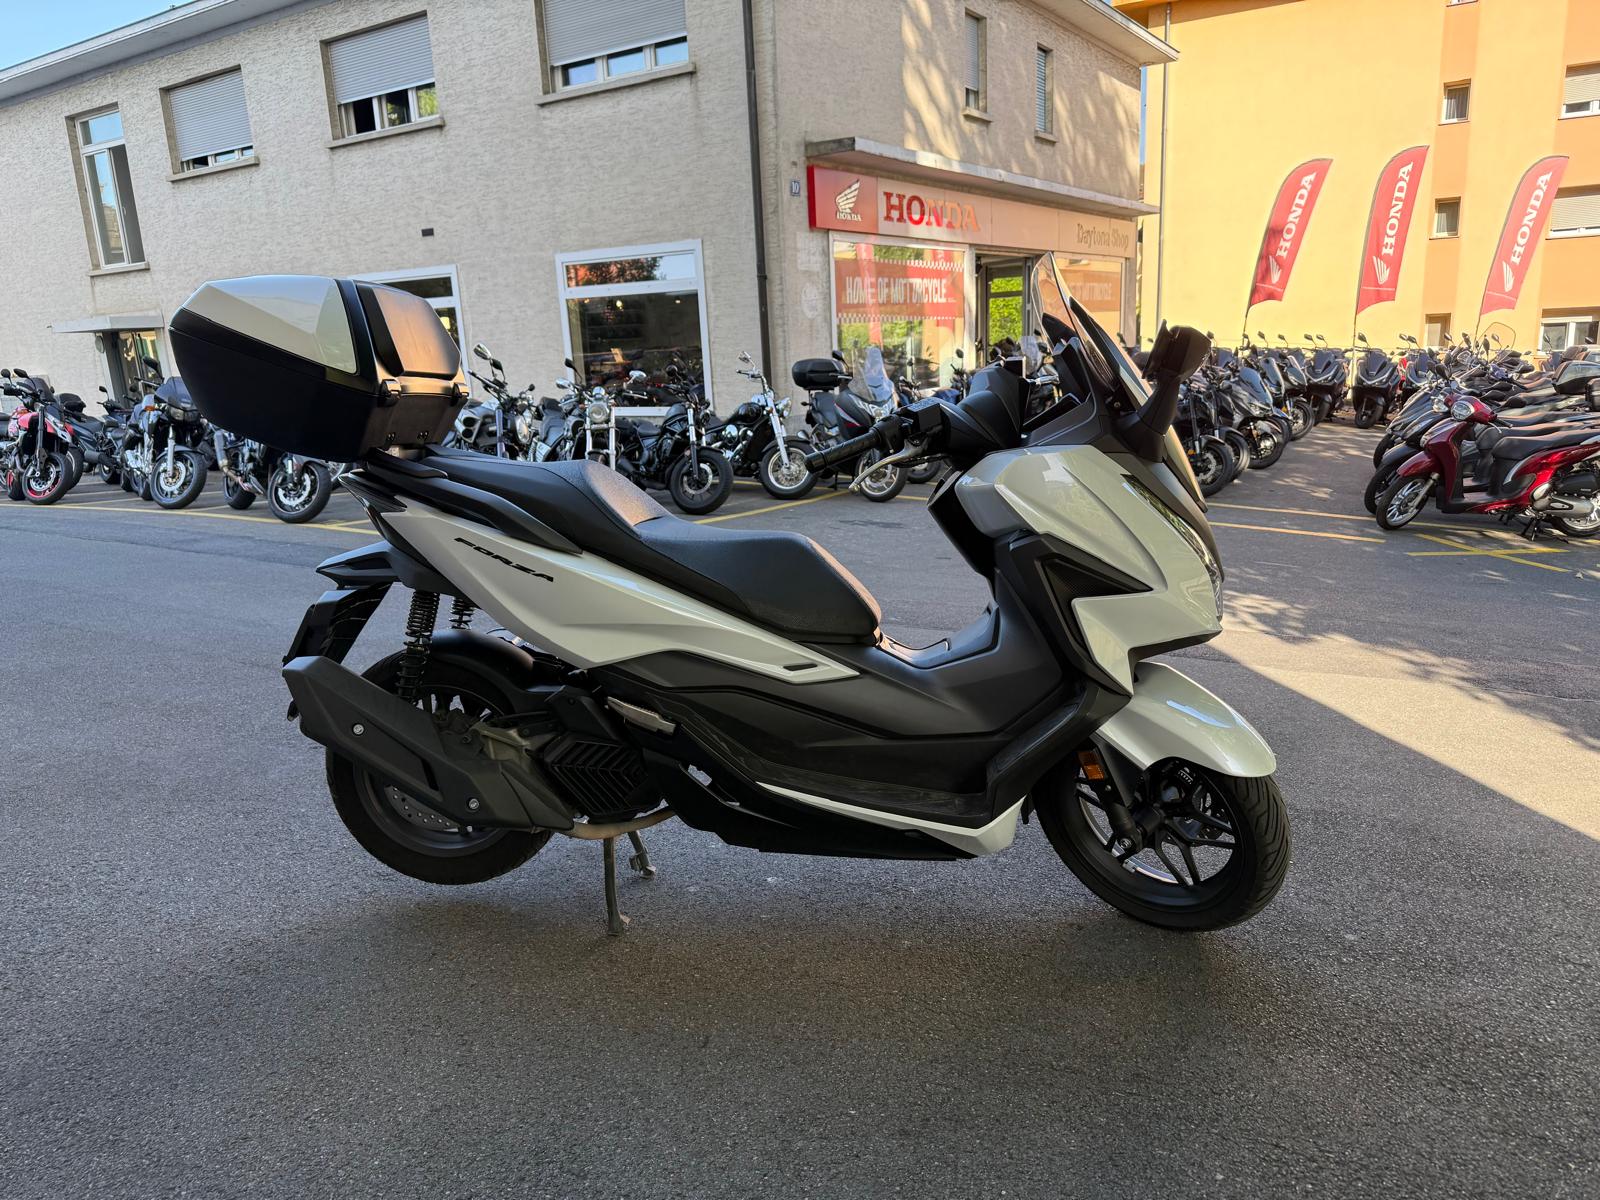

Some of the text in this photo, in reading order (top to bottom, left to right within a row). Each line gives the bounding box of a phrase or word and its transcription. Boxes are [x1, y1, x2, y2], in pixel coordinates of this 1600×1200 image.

[791, 181, 799, 194] 10
[836, 212, 862, 222] HONDA
[883, 191, 981, 232] HONDA
[1276, 172, 1317, 259] HONDA
[1382, 162, 1414, 256] HONDA
[1510, 171, 1552, 265] HONDA
[1077, 223, 1129, 252] Daytona Shop
[846, 276, 876, 304] HOME
[877, 277, 889, 304] OF
[454, 537, 554, 582] FORZA
